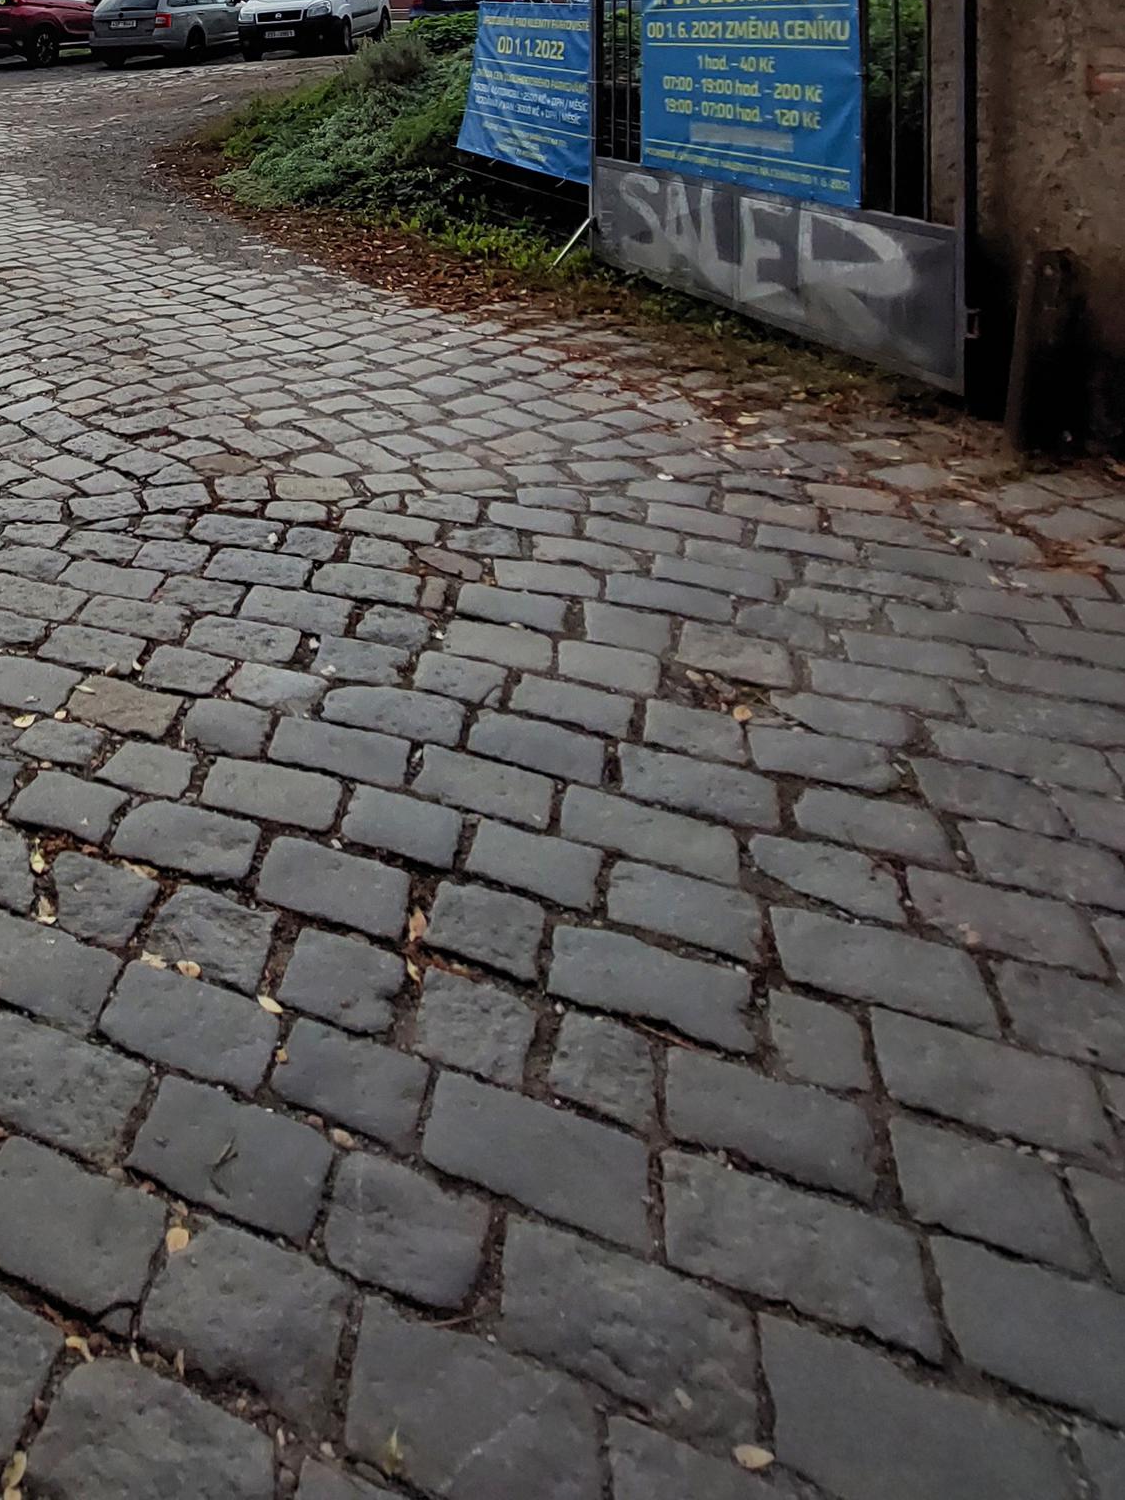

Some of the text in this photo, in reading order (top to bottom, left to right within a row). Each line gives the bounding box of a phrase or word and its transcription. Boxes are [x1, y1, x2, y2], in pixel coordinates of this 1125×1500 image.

[647, 21, 664, 38] OD
[691, 21, 722, 39] 2021
[725, 16, 780, 40] ZMĚNA
[784, 15, 850, 41] CENÍKU
[497, 35, 513, 54] OD
[663, 75, 693, 91] 07:00
[774, 82, 801, 101] 200
